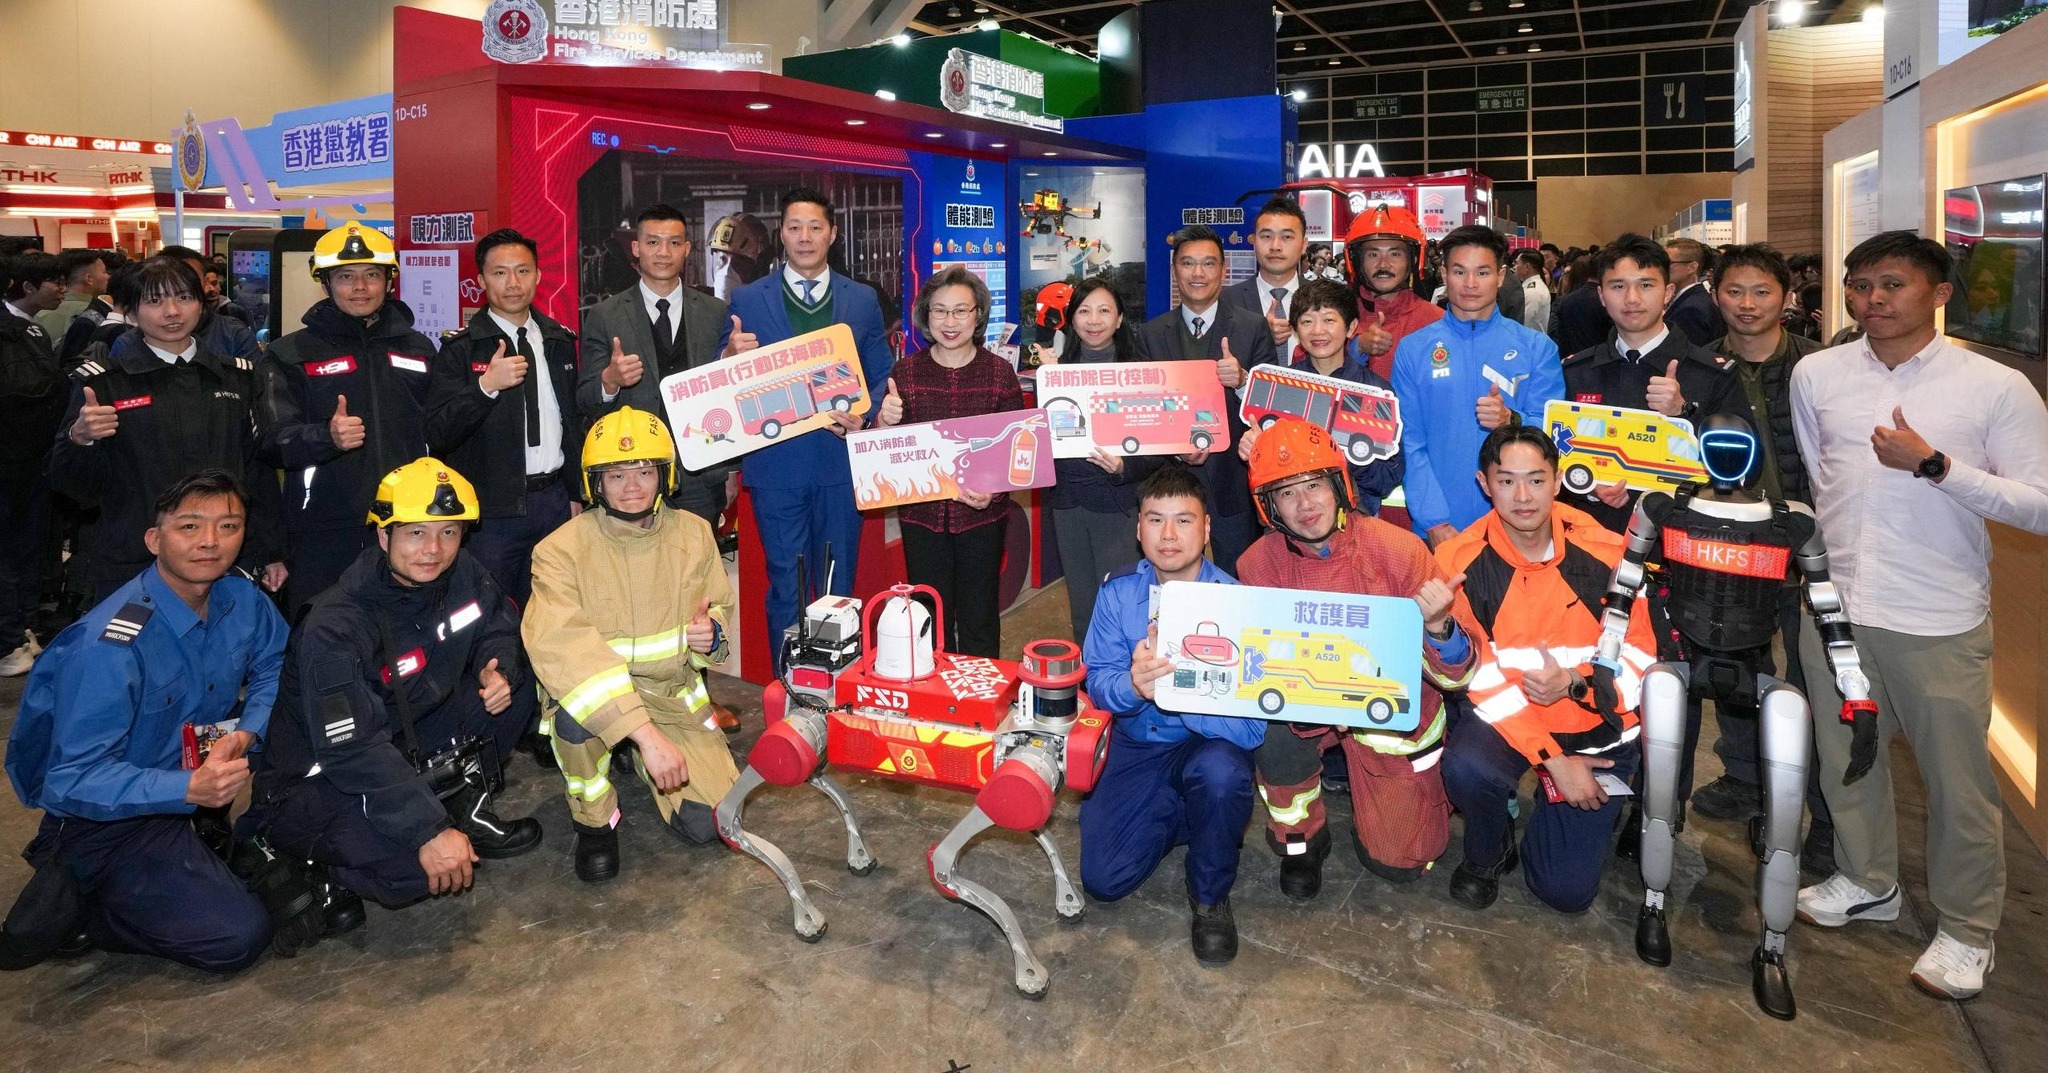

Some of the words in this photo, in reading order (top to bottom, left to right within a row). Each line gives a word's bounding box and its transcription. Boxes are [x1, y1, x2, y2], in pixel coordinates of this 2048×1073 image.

[554, 26, 600, 44] Hong
[605, 27, 648, 44] Kong
[554, 43, 587, 58] Fire
[591, 46, 661, 61] Services
[665, 47, 764, 64] Department
[1889, 55, 1912, 86] 1D-C16
[971, 84, 994, 102] Hong
[994, 89, 1016, 108] Kong
[1356, 99, 1386, 107] EMERGENCY
[1386, 97, 1398, 105] EXIT
[1478, 91, 1512, 99] EMERGENCY
[1513, 89, 1526, 97] EXIT
[395, 104, 428, 121] 1D-C15
[1356, 105, 1398, 117] 緊急出口
[1479, 98, 1526, 110] 緊急出口
[25, 133, 51, 146] ON
[53, 136, 78, 148] AIR
[92, 138, 117, 151] ON
[118, 140, 141, 152] AIR
[284, 116, 389, 168] 香港懲教署
[1298, 143, 1386, 178] AIA
[0, 169, 58, 184] THK
[109, 171, 143, 185] RTHK
[947, 205, 994, 227] 體能測驗
[1184, 208, 1243, 224] 體能測驗
[412, 214, 474, 242] 視力測試
[669, 337, 834, 403] 消防員(行動及海務)
[1045, 367, 1166, 388] 消防隊目(控制)
[854, 435, 917, 454] 加入消防處
[1627, 431, 1656, 443] A520
[889, 447, 940, 465] 滅火救人
[1697, 543, 1749, 568] HKFS
[1294, 601, 1370, 629] 救護員
[1315, 652, 1341, 662] A520
[857, 684, 909, 710] FSD
